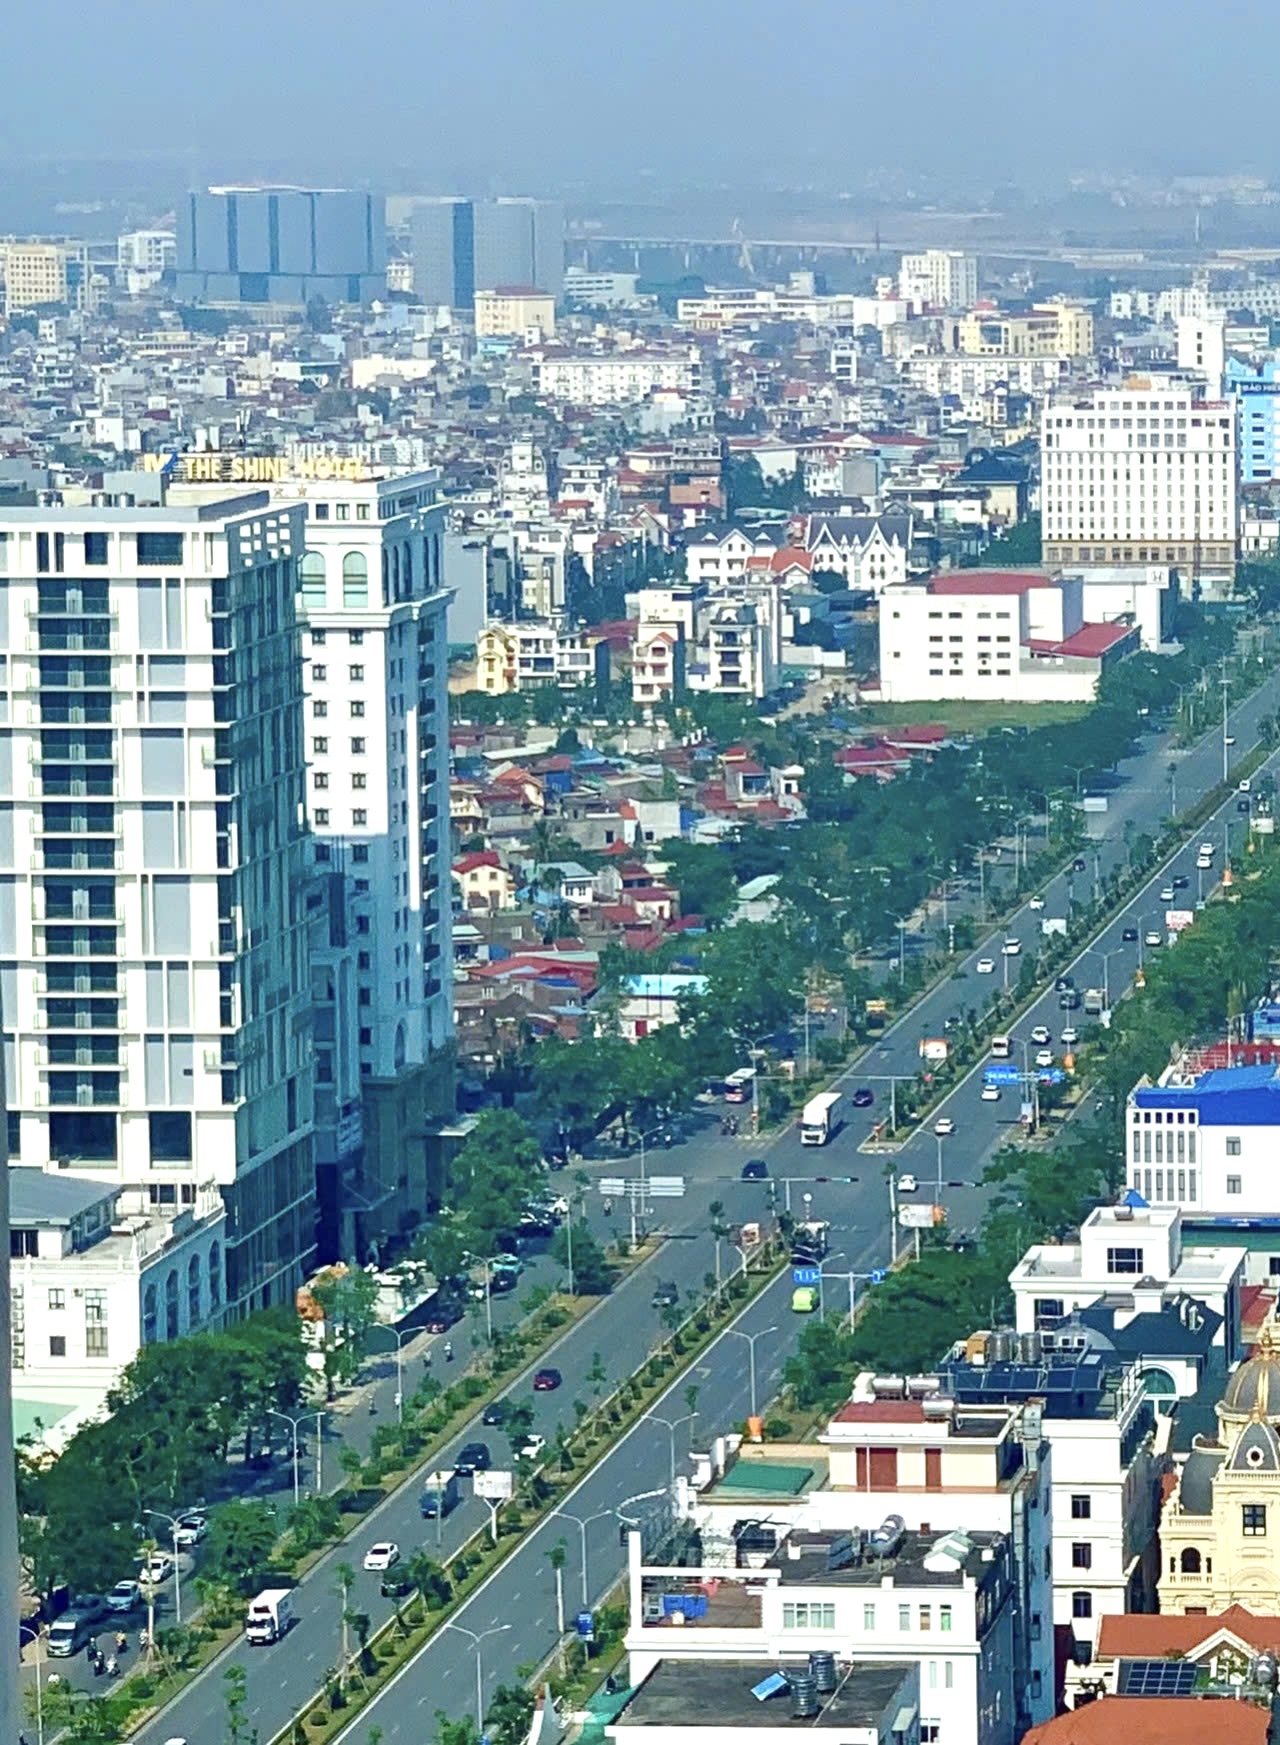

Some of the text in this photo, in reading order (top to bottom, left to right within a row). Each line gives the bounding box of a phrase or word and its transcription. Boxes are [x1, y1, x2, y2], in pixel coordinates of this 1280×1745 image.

[185, 458, 221, 479] THE
[231, 457, 288, 480] SHINE
[301, 457, 365, 480] HOTEL
